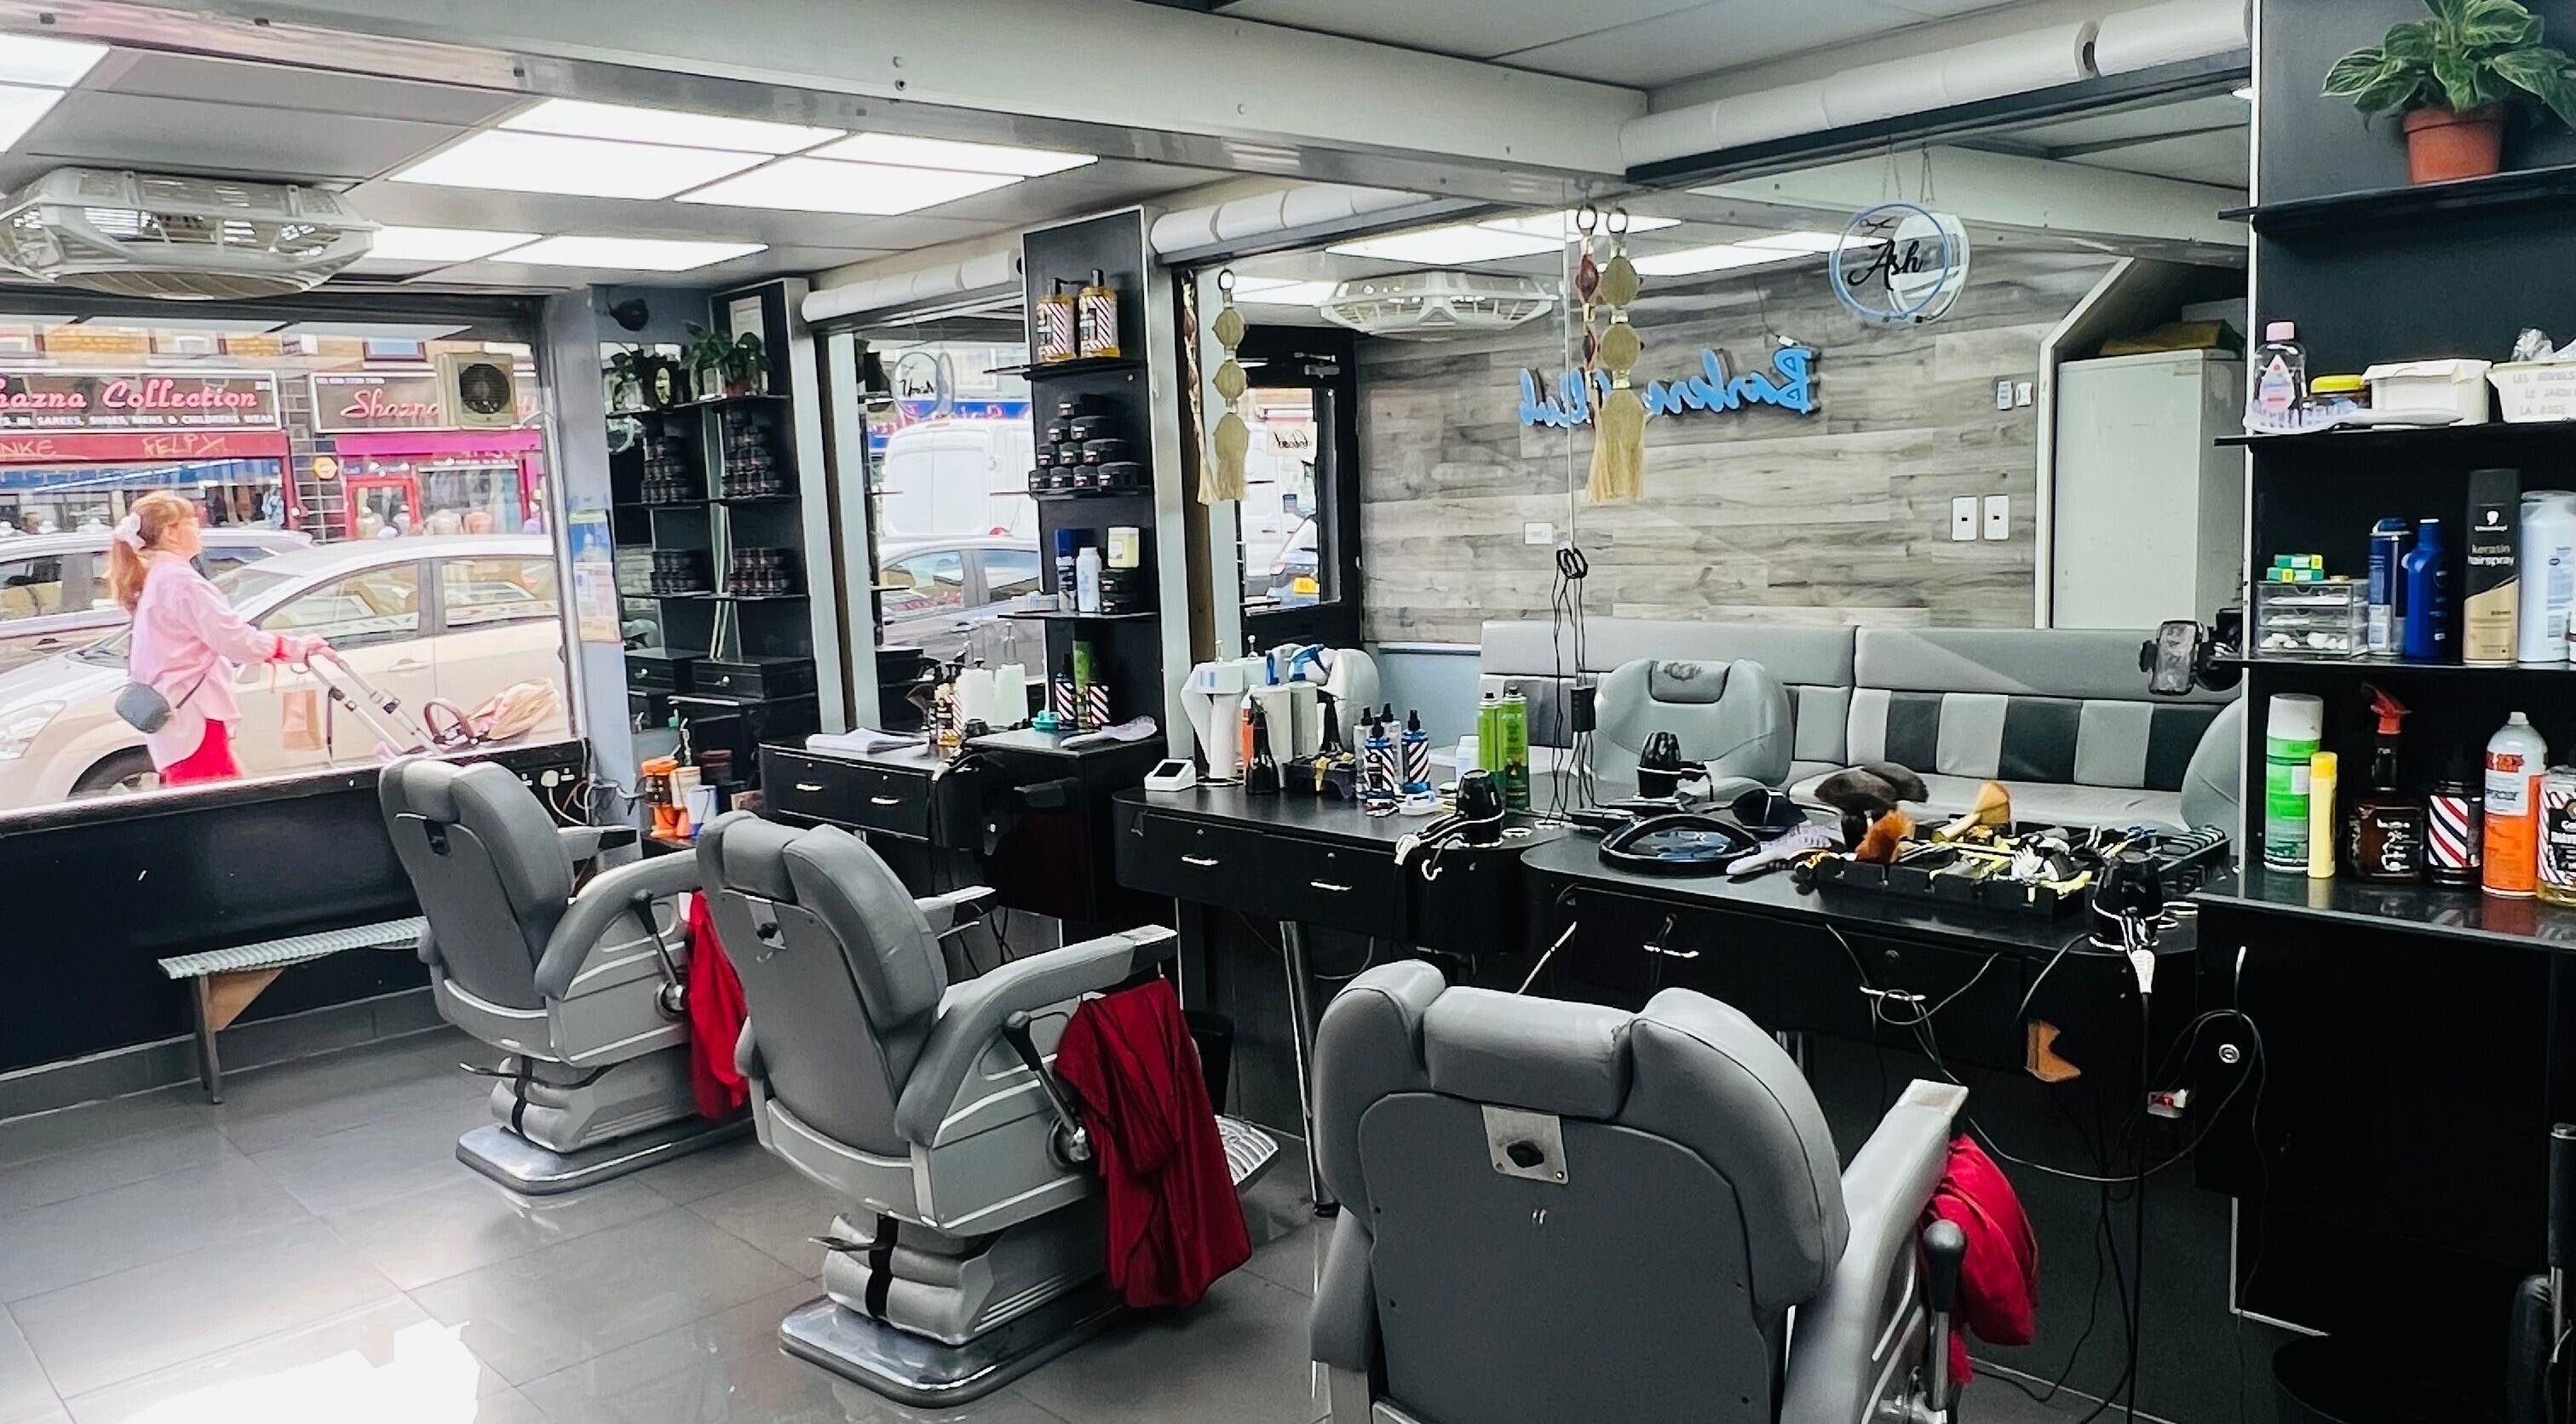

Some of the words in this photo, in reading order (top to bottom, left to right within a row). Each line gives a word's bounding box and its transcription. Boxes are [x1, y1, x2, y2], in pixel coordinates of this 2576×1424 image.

[1847, 238, 1923, 291] Ash
[101, 377, 258, 409] Collection
[341, 388, 440, 420] Shazna
